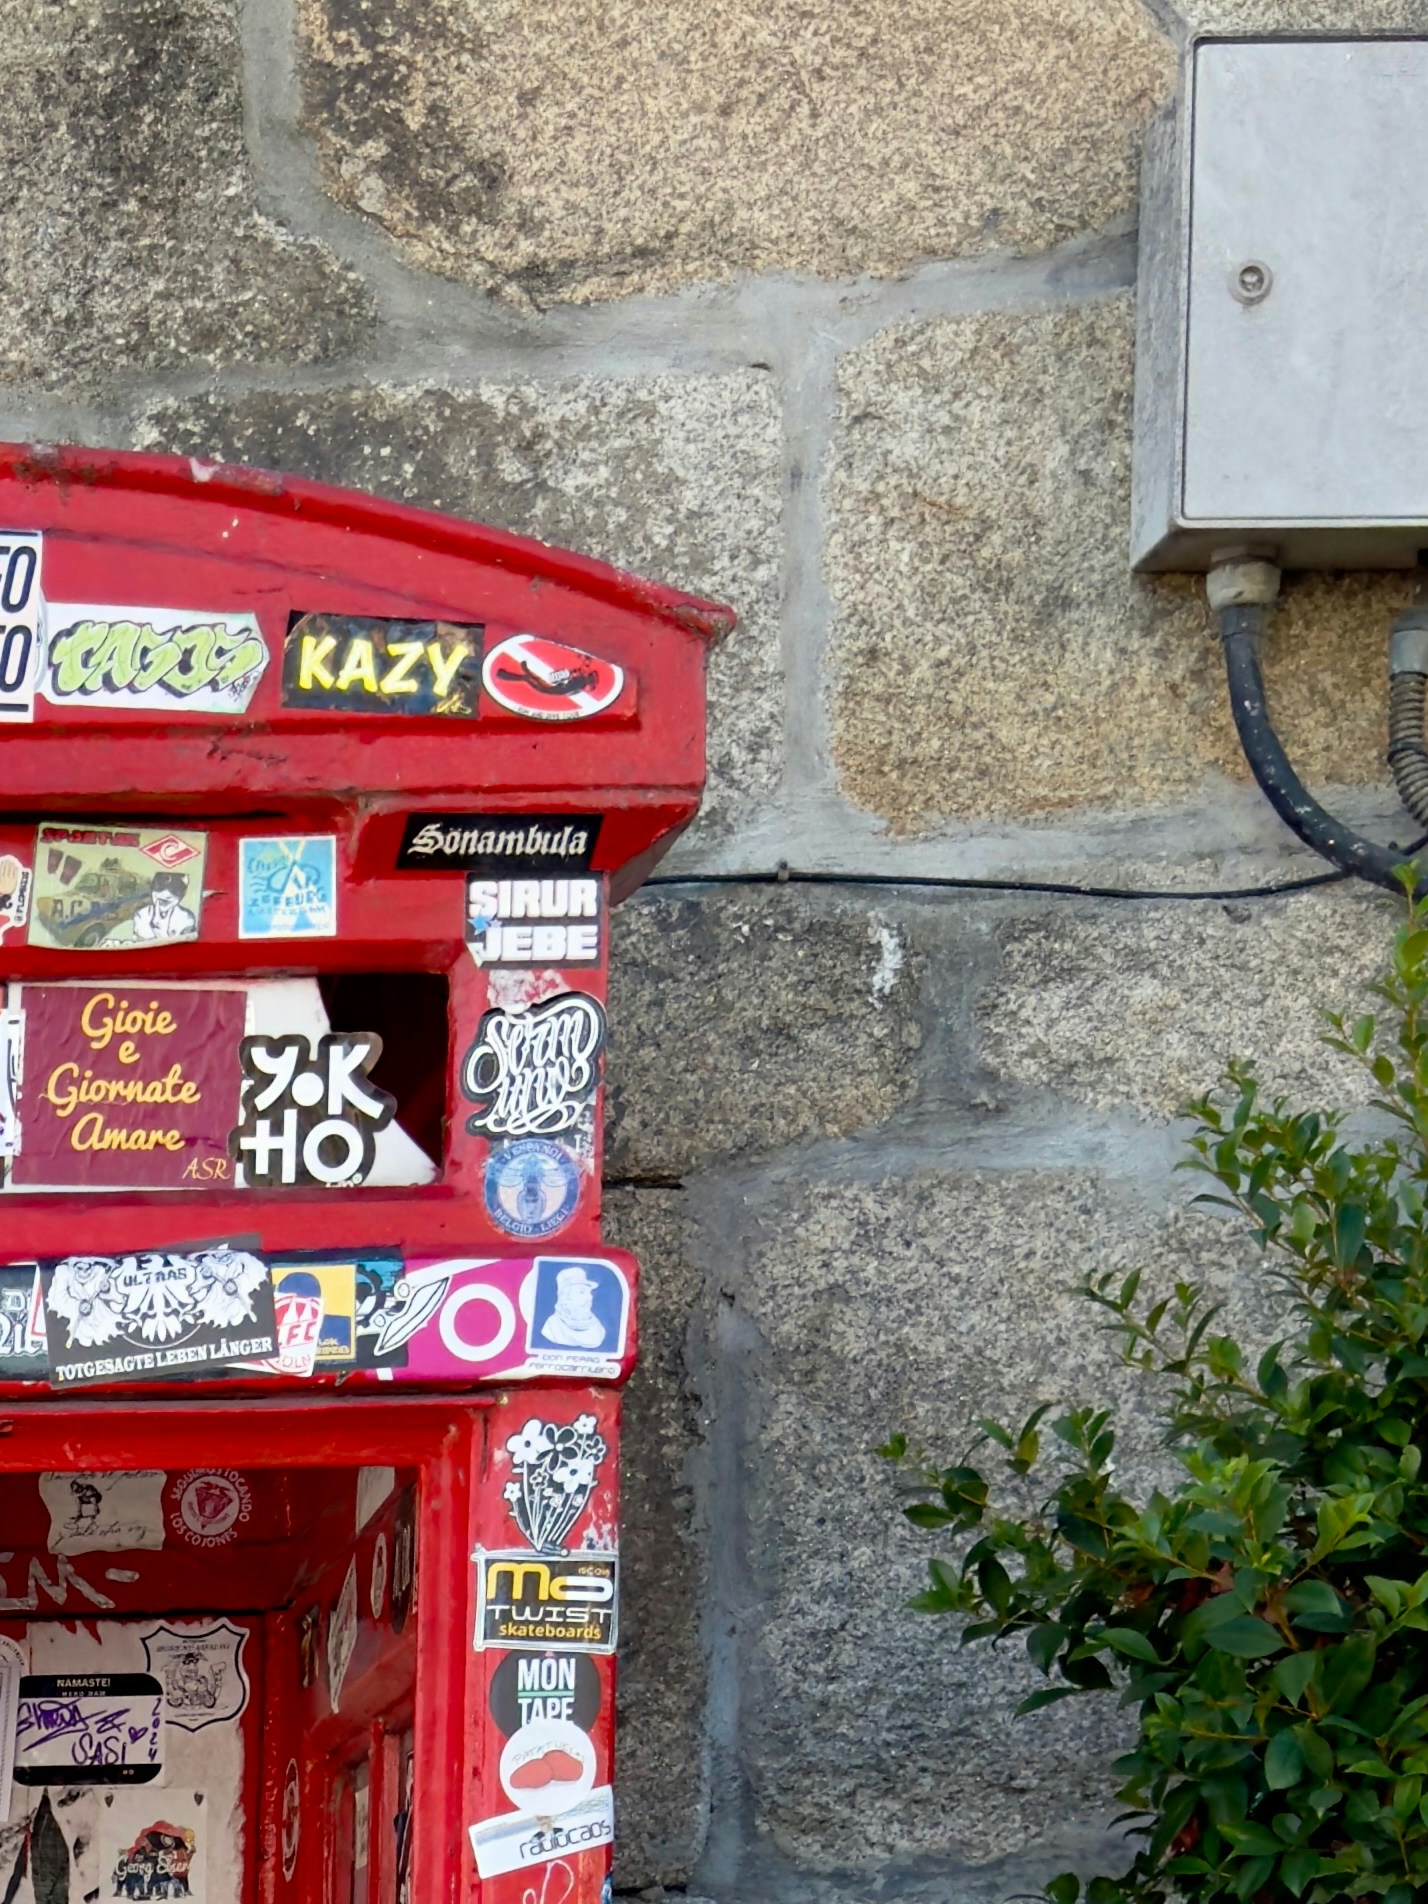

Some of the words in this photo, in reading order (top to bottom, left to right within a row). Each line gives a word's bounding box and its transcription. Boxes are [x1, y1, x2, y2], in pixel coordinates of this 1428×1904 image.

[296, 635, 472, 698] KAZY
[470, 879, 599, 918] SIRUR
[81, 993, 176, 1049] Gioie
[119, 1040, 141, 1063] e
[46, 1063, 201, 1118] Giornate
[71, 1114, 186, 1154] Amare
[181, 1158, 231, 1181] ASR
[121, 1266, 189, 1289] ULTRAS
[55, 1354, 155, 1382] TOTGESAGTE
[155, 1346, 208, 1368] LEBEN
[209, 1336, 273, 1361] LÄNGER
[485, 1604, 614, 1624] TWIST
[498, 1622, 603, 1641] skateboards
[56, 1677, 112, 1688] NAMASTE!
[516, 1657, 577, 1691] MON
[516, 1696, 576, 1727] TAPE
